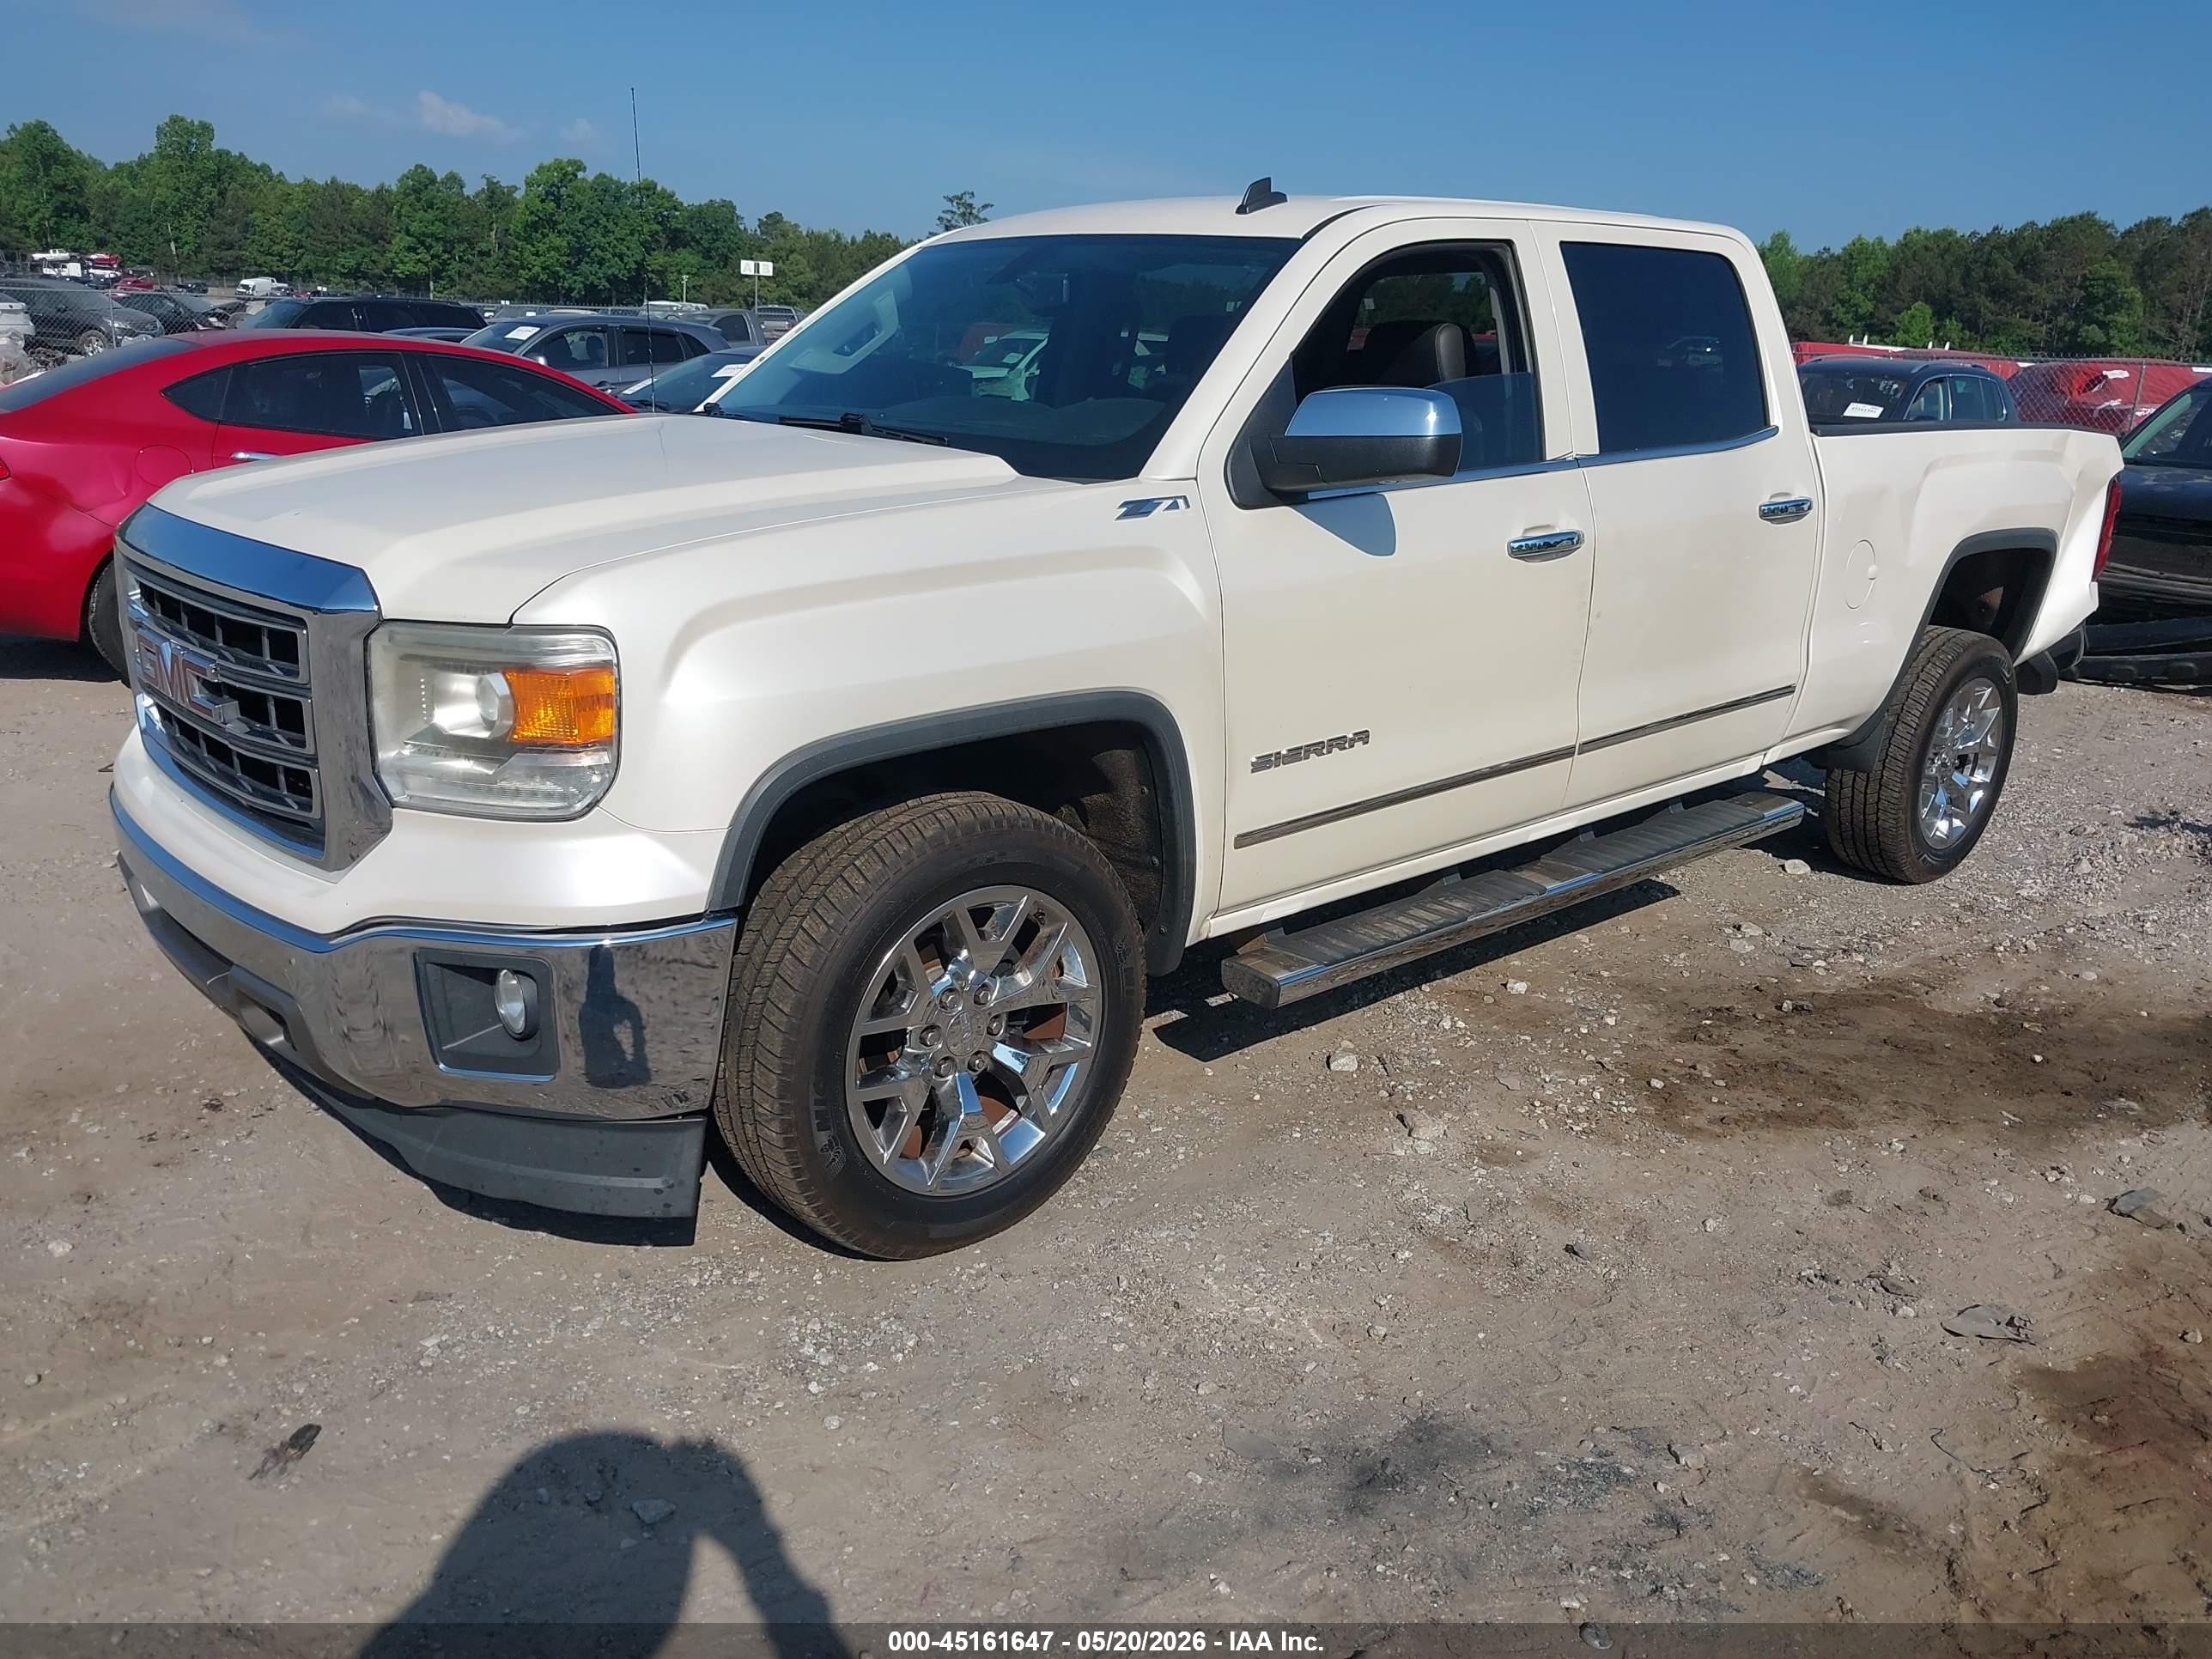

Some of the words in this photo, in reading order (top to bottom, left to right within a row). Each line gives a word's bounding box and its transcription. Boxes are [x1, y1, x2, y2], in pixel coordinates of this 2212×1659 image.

[1114, 495, 1191, 520] Z71
[137, 629, 227, 722] GMC
[1250, 729, 1370, 774] SIERRA
